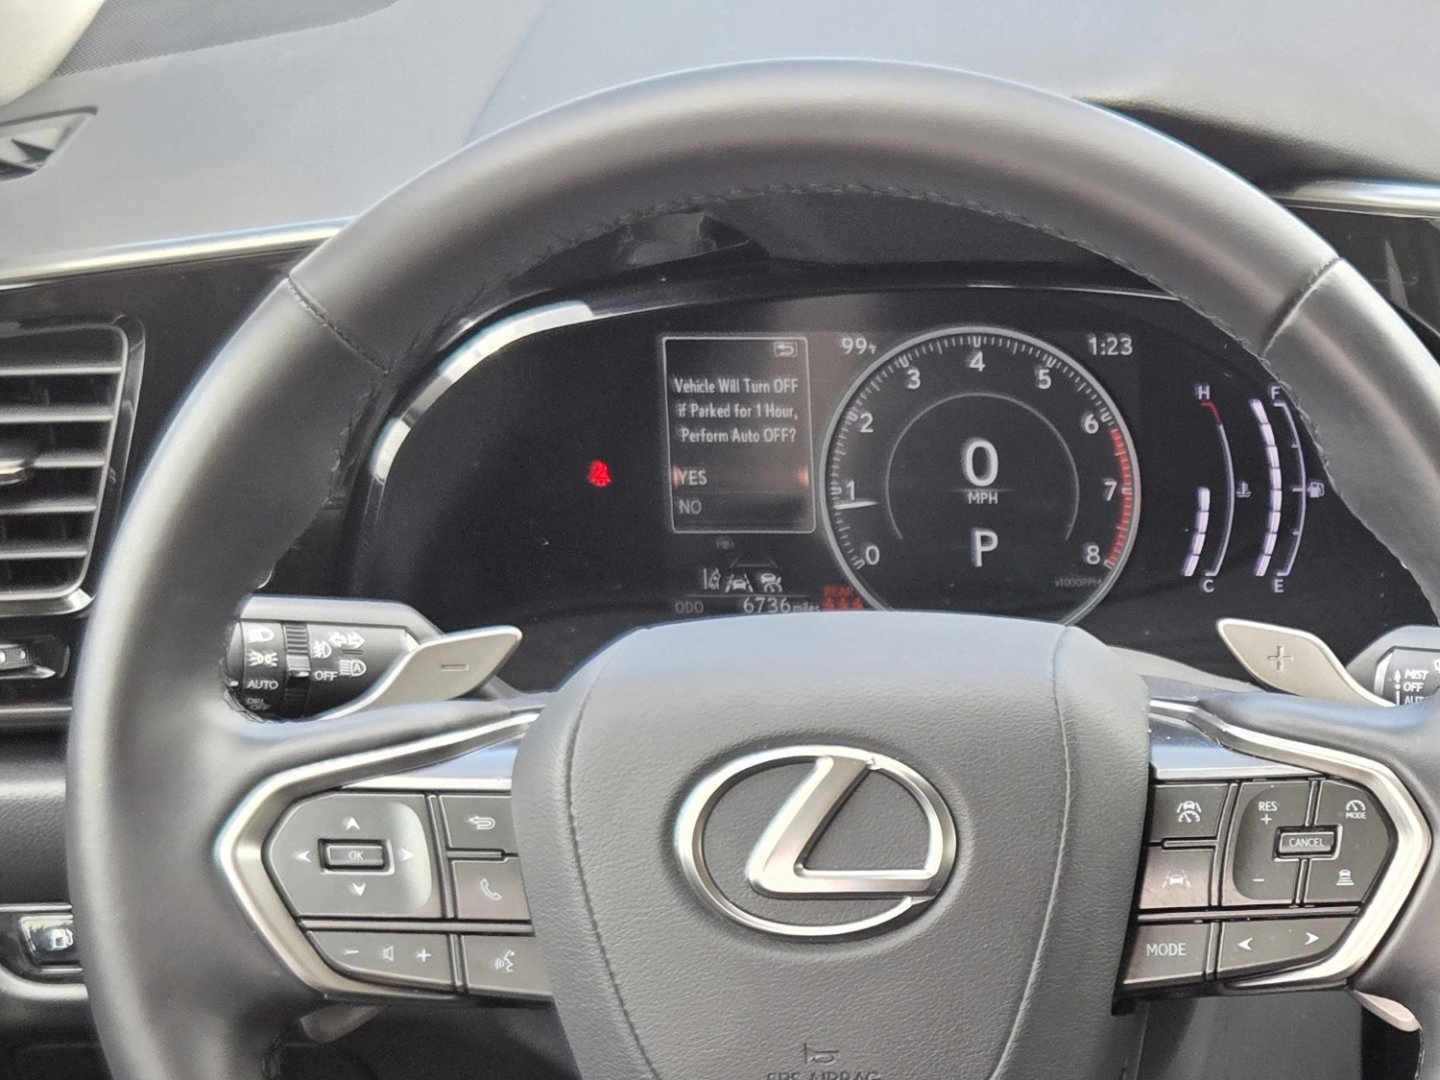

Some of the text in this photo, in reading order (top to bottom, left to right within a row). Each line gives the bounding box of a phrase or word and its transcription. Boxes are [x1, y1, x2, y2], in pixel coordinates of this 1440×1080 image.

[1088, 336, 1133, 355] 1:23
[969, 352, 985, 372] 4
[674, 378, 798, 393] Vehicle Will Turn OFF
[907, 370, 921, 389] 3
[1038, 370, 1052, 389] 5
[1197, 385, 1210, 400] H
[1271, 386, 1280, 400] F
[678, 403, 798, 420] if Parked for 1 Hour,
[860, 414, 874, 433] 2
[1084, 414, 1099, 434] 6
[681, 428, 797, 443] Perform Auto OFF?
[965, 439, 998, 487] 0
[678, 470, 707, 485] YES
[847, 481, 855, 500] 1
[967, 492, 998, 504] MPH
[1104, 481, 1117, 501] 7
[678, 499, 702, 514] NO
[865, 545, 880, 565] 0
[974, 530, 998, 567] P
[1086, 545, 1101, 565] 8
[1203, 579, 1214, 593] C
[1274, 579, 1284, 593] E
[675, 601, 704, 613] ODO
[743, 597, 820, 613] 6736 miles
[314, 670, 337, 681] OFF
[1404, 669, 1429, 680] MIST
[247, 679, 279, 690] AUTO
[1403, 682, 1424, 692] OFF
[1259, 801, 1277, 812] RES
[1346, 811, 1366, 819] MODE
[1289, 838, 1325, 847] CANCEL
[348, 850, 364, 861] OK
[1146, 943, 1186, 956] MODE
